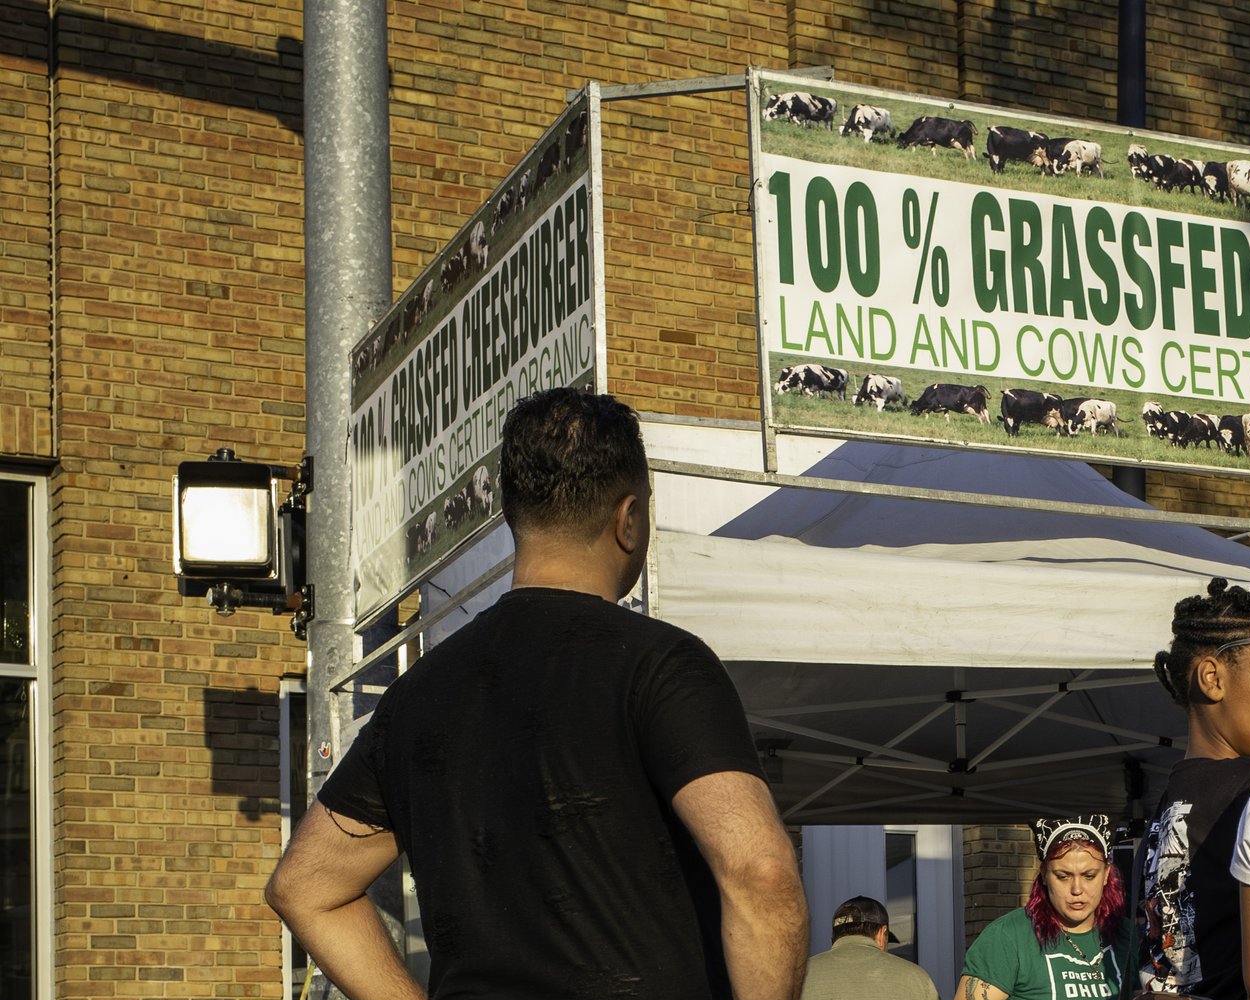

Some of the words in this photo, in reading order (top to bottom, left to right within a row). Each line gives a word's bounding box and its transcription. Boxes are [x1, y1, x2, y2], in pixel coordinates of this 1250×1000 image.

[769, 171, 881, 298] 100
[902, 187, 951, 308] %
[353, 406, 374, 512] 100
[377, 391, 388, 493] %
[391, 315, 458, 478] GRASSFED
[462, 182, 590, 412] CHEESEBURGER
[779, 295, 897, 362] LAND
[911, 313, 1001, 371] AND
[1016, 324, 1147, 389] COWS
[384, 479, 406, 538] AND
[408, 443, 446, 514] COWS
[450, 380, 514, 480] CERTIFIED
[518, 313, 590, 402] ORGANIC
[1064, 983, 1113, 998] OHIO
